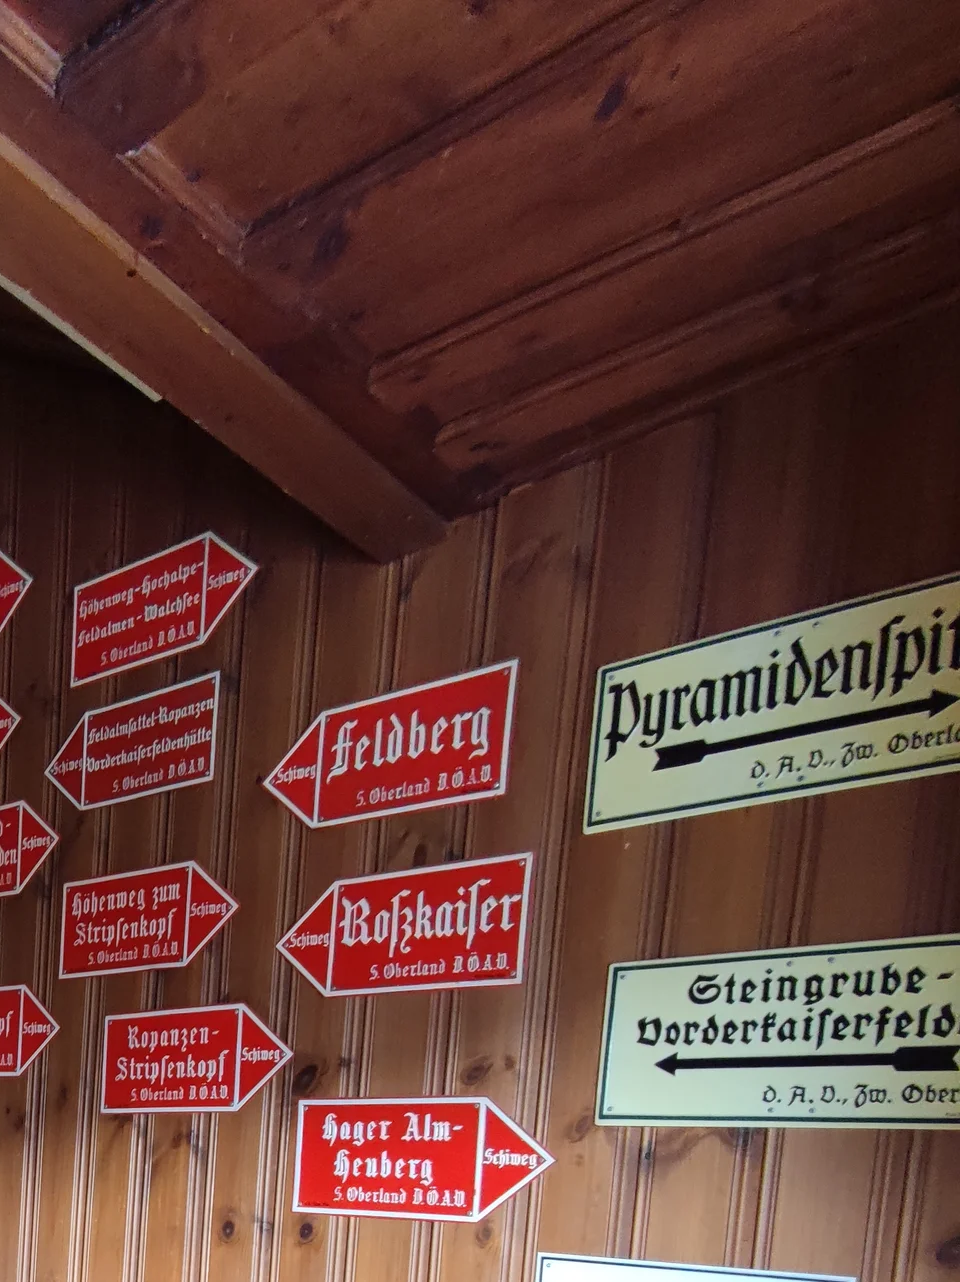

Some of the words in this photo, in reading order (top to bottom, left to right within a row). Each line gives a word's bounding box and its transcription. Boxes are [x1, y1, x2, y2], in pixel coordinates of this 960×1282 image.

[207, 567, 245, 590] Schiweg
[110, 637, 153, 661] Oberland
[326, 706, 491, 784] Feldberg
[53, 758, 83, 776] Schiweg
[275, 764, 316, 785] Schiweg
[122, 768, 164, 790] Oberland
[355, 790, 366, 807] S.
[369, 777, 430, 805] Oberland
[22, 835, 51, 851] Schiweg
[72, 888, 146, 920] Höhenweg
[152, 882, 181, 910] zum
[190, 901, 227, 918] Schiweg
[288, 932, 329, 950] Schiweg
[97, 947, 138, 964] Oberland
[369, 964, 380, 981] S.
[383, 959, 445, 980] Oberland
[22, 1021, 51, 1036] Schiweg
[127, 1025, 220, 1053] Ropanzen-
[241, 1047, 280, 1064] Schiweg
[141, 1087, 184, 1101] Oberland
[321, 1112, 393, 1146] Hager
[401, 1111, 464, 1142] Alm-
[333, 1149, 434, 1184] Heuberg
[483, 1148, 538, 1169] Schiweg
[332, 1186, 344, 1202] S.
[346, 1186, 406, 1204] Oberland
